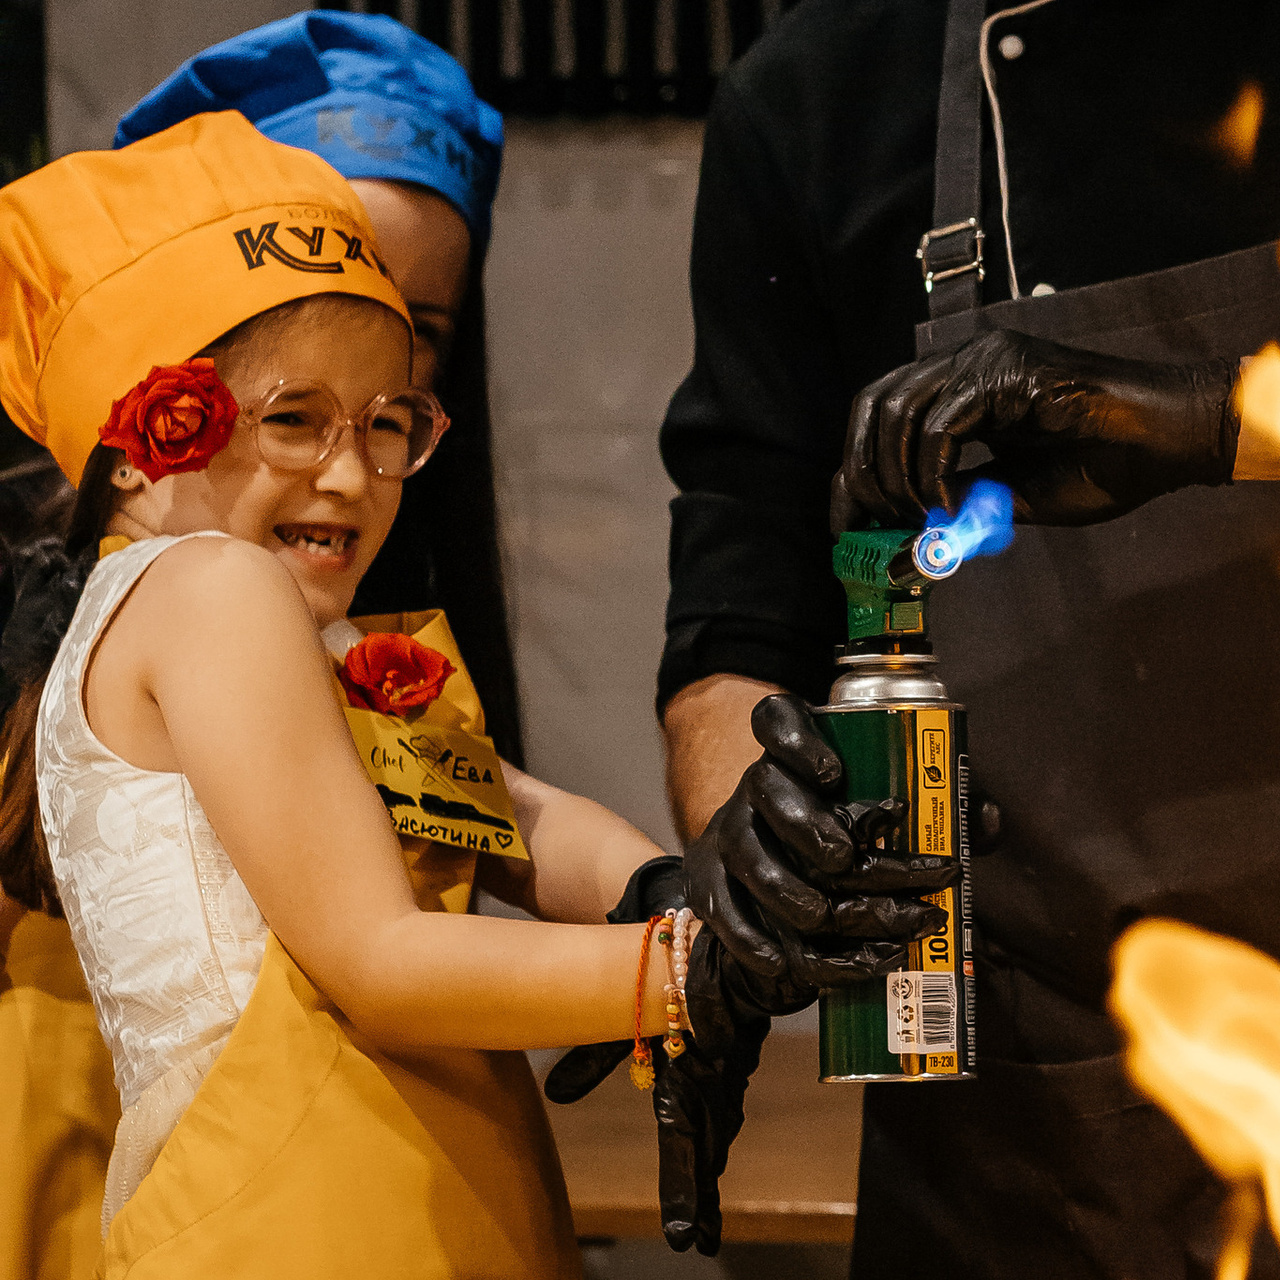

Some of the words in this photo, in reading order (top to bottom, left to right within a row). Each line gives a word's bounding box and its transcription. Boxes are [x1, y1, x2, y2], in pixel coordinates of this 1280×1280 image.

[924, 824, 932, 852] САМЫЙ
[931, 796, 939, 852] ЭКОЛОГИЧНЫЙ
[928, 1055, 954, 1068] TB-230
